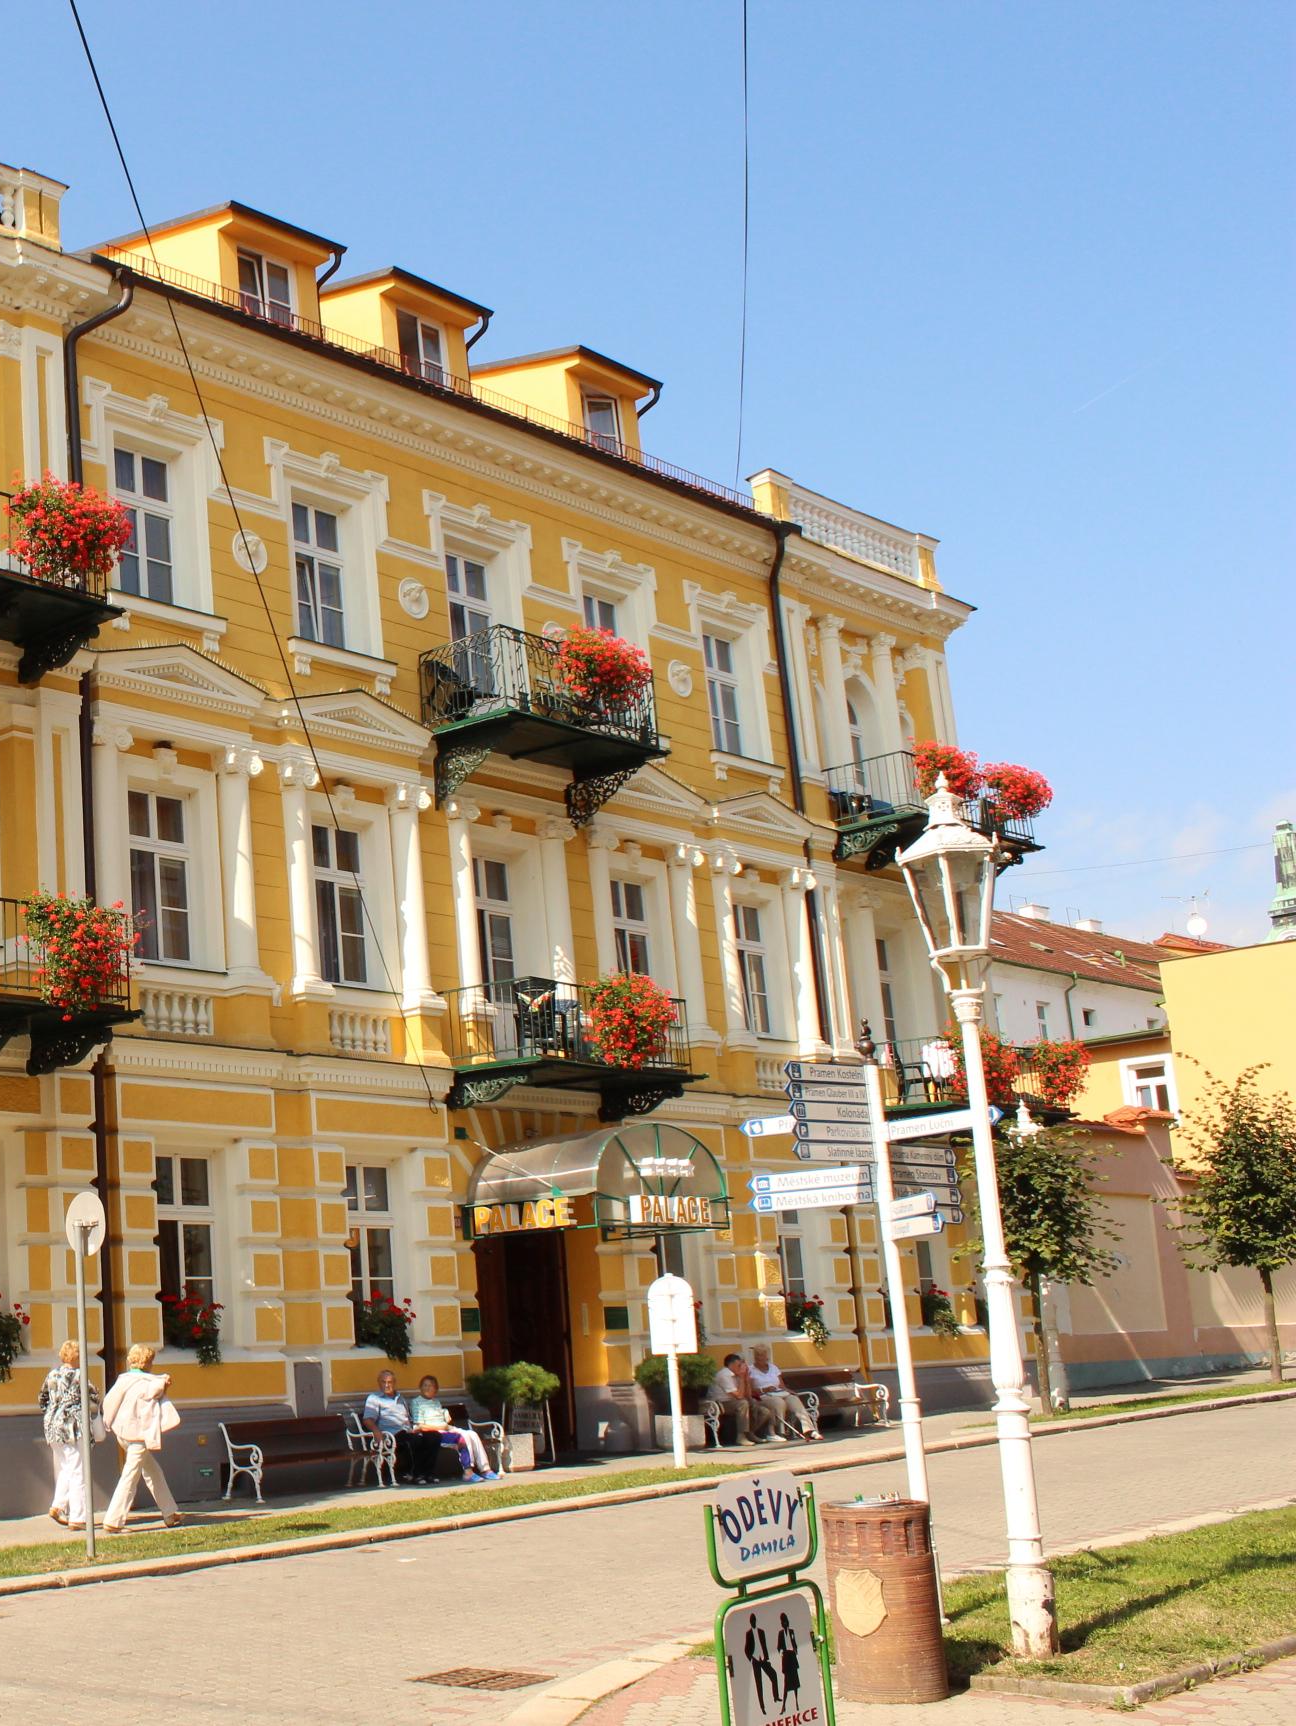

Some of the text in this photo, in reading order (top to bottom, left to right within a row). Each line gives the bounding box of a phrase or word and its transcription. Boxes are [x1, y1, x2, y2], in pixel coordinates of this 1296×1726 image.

[810, 1067, 836, 1080] Pramen
[804, 1087, 826, 1097] Pramen
[891, 1124, 926, 1136] Pramen
[823, 1171, 868, 1184] muzeum
[822, 1190, 871, 1203] knihovna
[474, 1197, 571, 1235] PALACE
[640, 1195, 711, 1224] PALACE
[721, 1479, 799, 1544] ODĚVY
[739, 1534, 796, 1562] DAMILA
